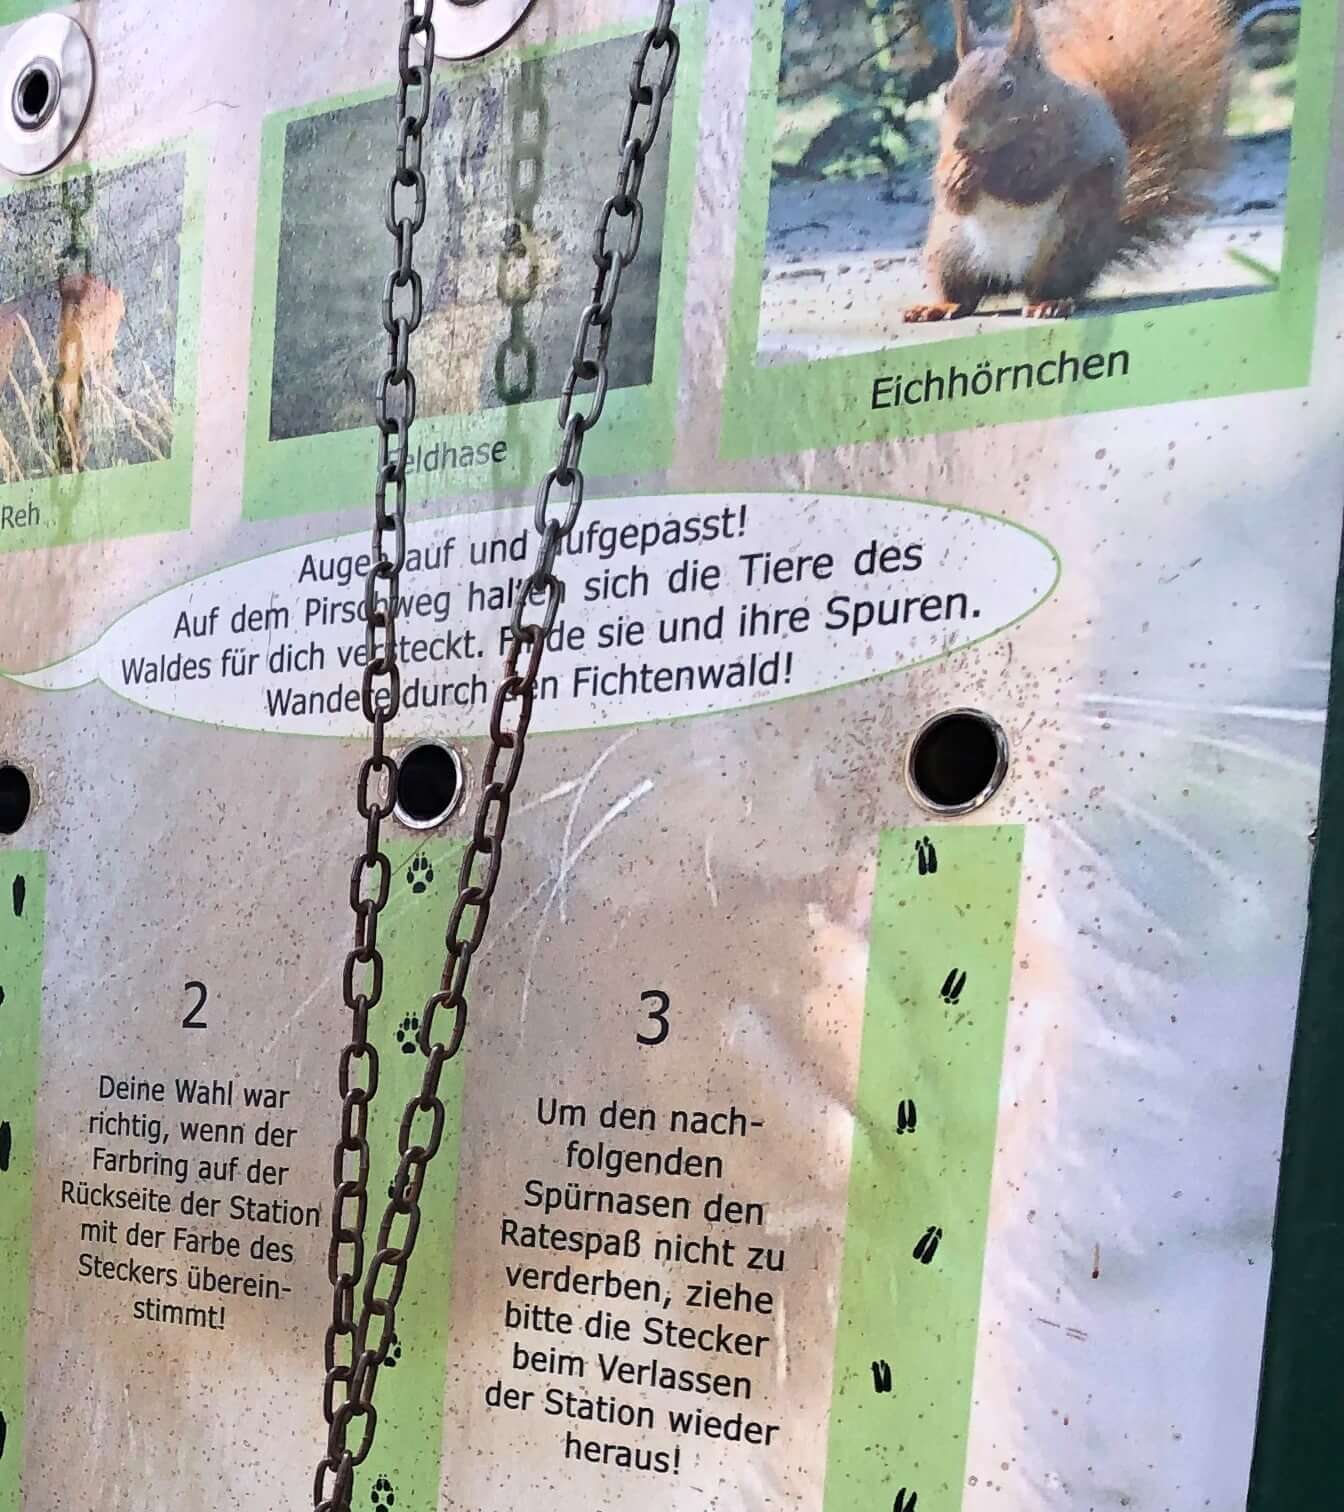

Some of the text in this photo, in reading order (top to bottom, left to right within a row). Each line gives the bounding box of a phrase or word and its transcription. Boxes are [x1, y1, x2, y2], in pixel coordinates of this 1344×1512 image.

[872, 350, 1130, 410] Eichhörnchen
[2, 501, 40, 530] Reh
[299, 504, 747, 586] Auge auf und ufgepasst!
[173, 606, 220, 639] Auf
[231, 604, 289, 634] dem
[584, 565, 649, 602] sich
[669, 560, 721, 594] die
[740, 551, 834, 587] Tiere
[855, 540, 924, 576] des
[122, 591, 982, 685] Waldes für dich verteckt. Fde sie und ihre Spuren.
[267, 682, 391, 717] Wandee
[402, 673, 488, 709] durch
[572, 651, 793, 698] Fichtenwald!
[181, 981, 208, 1029] 2
[636, 989, 671, 1046] 3
[98, 1075, 290, 1109] Deine Wahl war
[88, 1111, 298, 1148] richtig, wenn der
[536, 1097, 763, 1137] Um den nach-
[92, 1147, 289, 1186] Farbring auf der
[567, 1140, 723, 1178] folgenden
[61, 1180, 321, 1228] Rückseite der Station
[524, 1179, 764, 1226] Spürnasen den
[80, 1219, 294, 1264] mit der Farbe des
[500, 1218, 785, 1272] Ratespaß nicht zu
[78, 1253, 292, 1300] Steckers überein-
[505, 1265, 774, 1315] verderben, ziehe
[133, 1299, 226, 1331] stimmt!
[505, 1299, 770, 1358] bitte die Stecker
[512, 1341, 752, 1400] beim Verlassen
[484, 1380, 780, 1447] der Station wieder
[564, 1431, 681, 1476] heraus!
